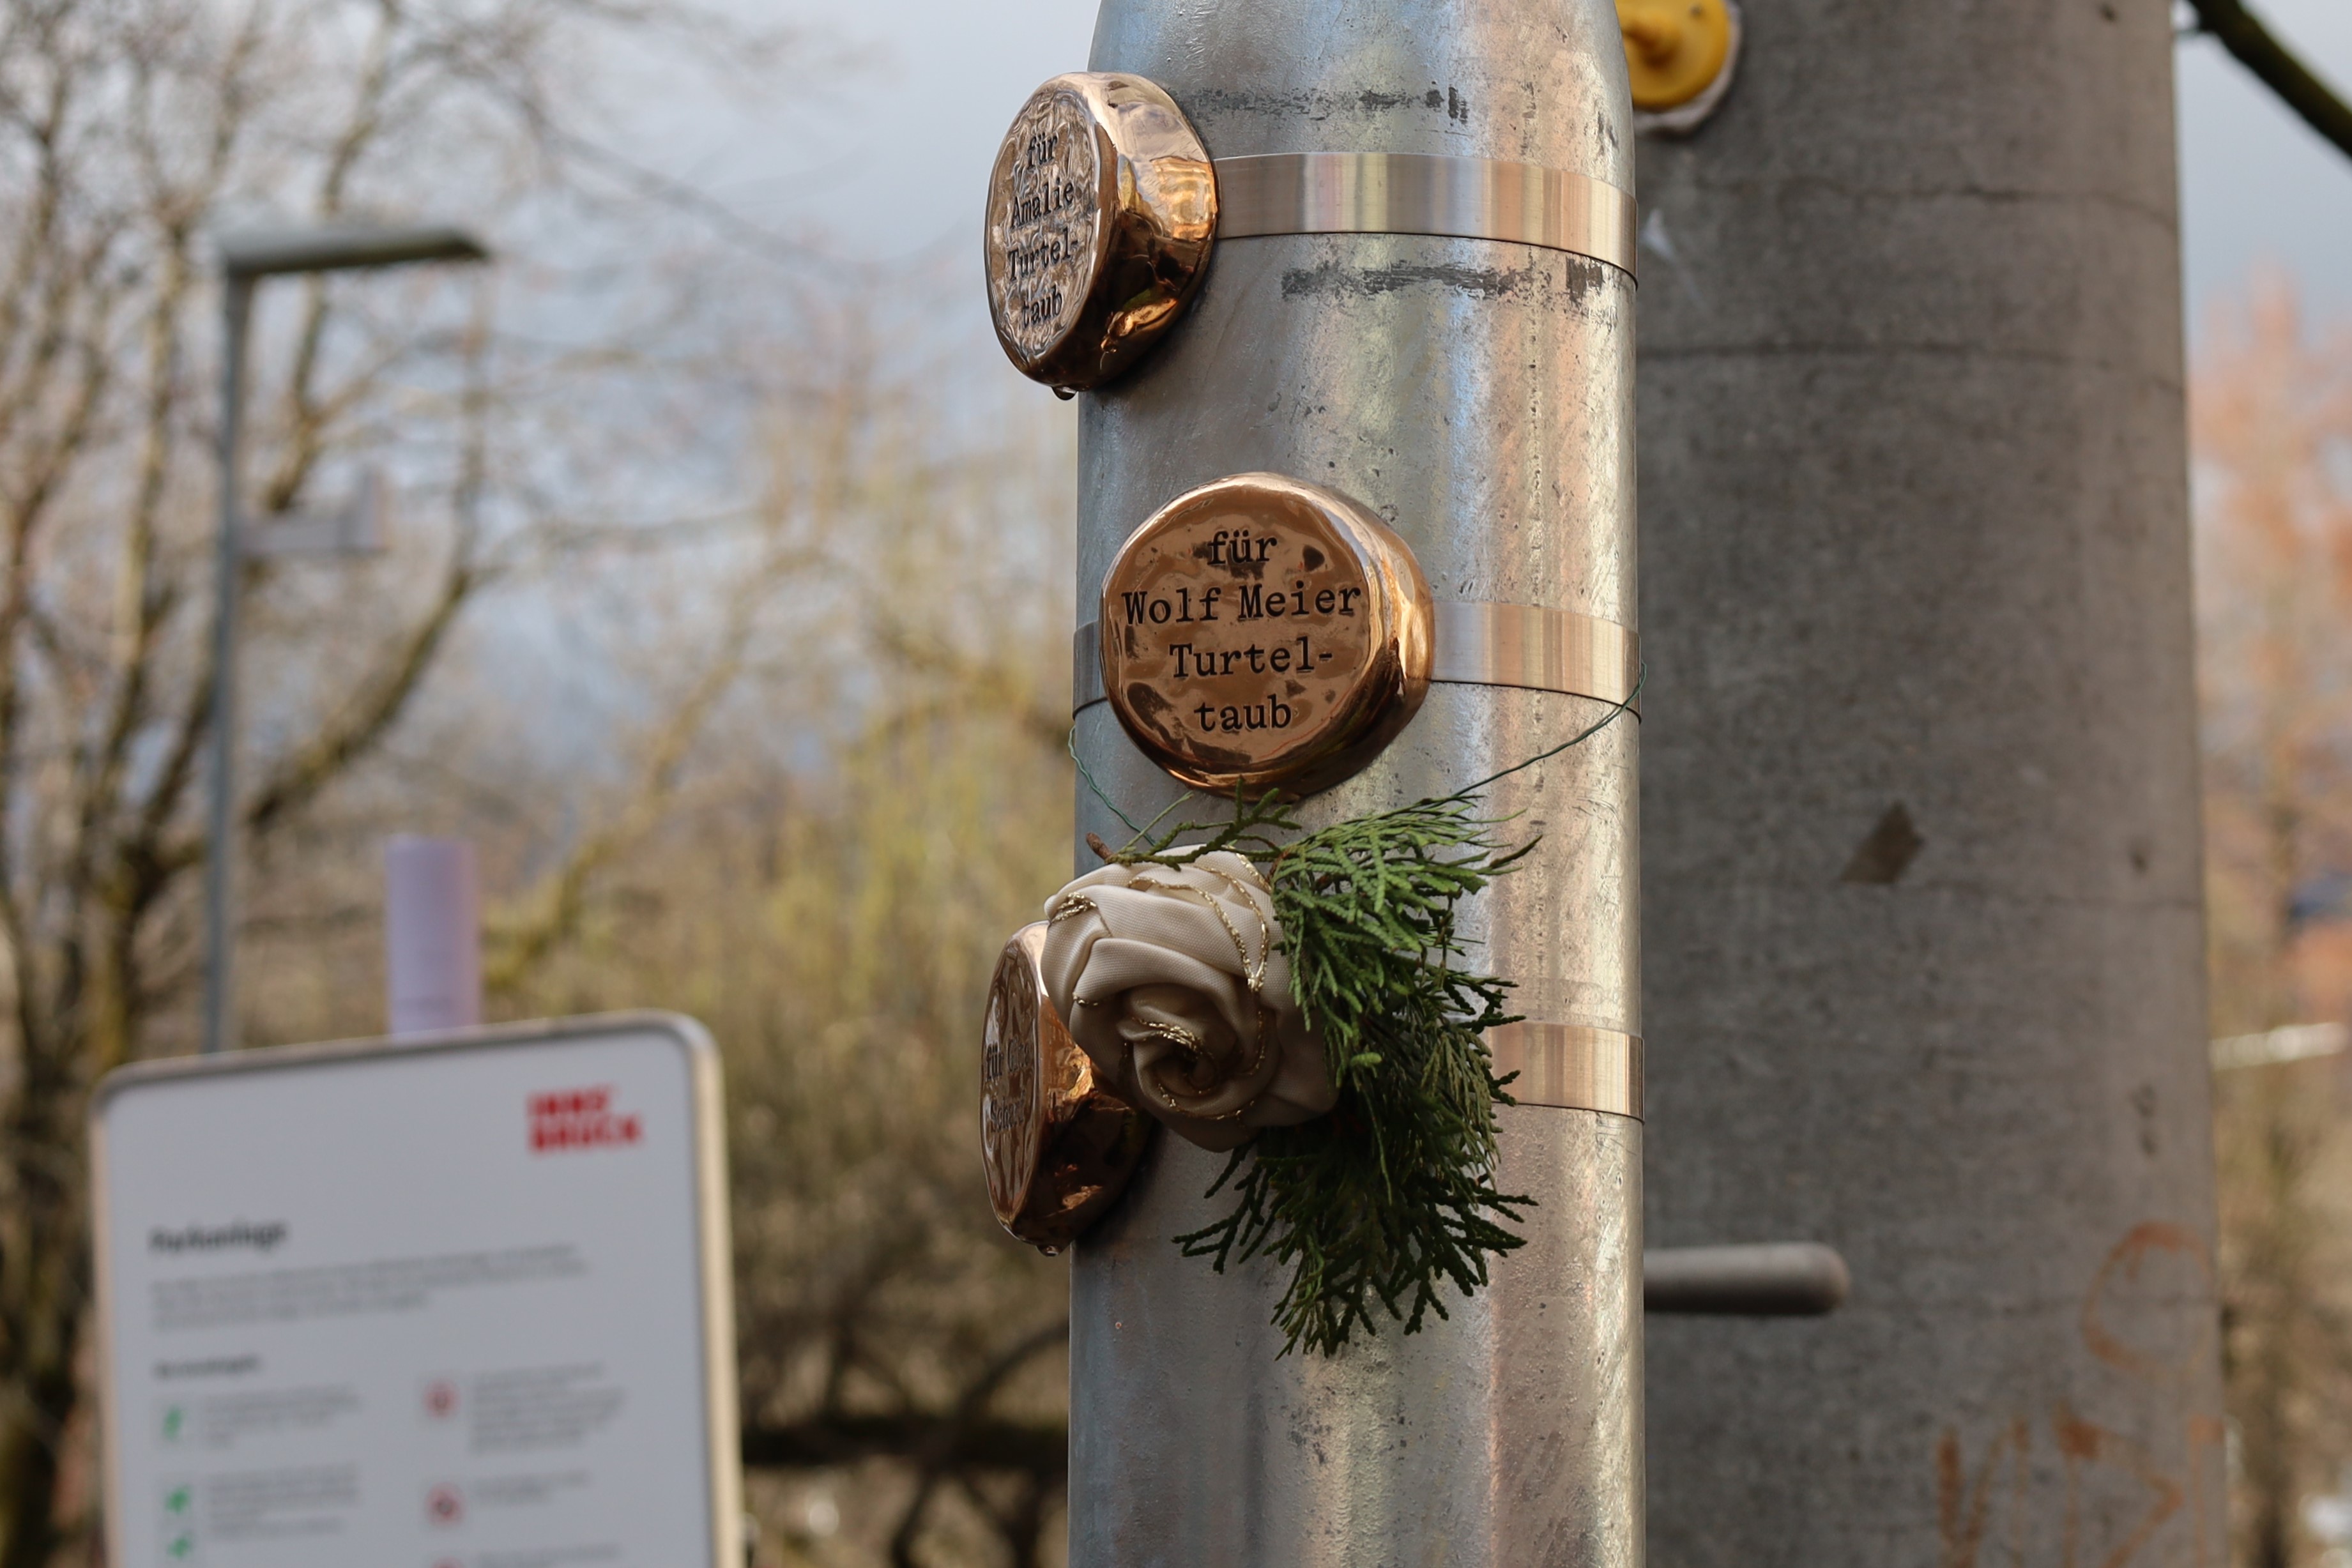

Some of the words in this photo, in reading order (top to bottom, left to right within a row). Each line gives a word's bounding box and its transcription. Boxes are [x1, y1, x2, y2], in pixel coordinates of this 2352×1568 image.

[1027, 133, 1058, 169] für
[1011, 177, 1074, 229] Amalie
[1007, 227, 1078, 282] Turtel-
[1022, 285, 1062, 329] taub
[1207, 530, 1278, 566] für
[1122, 587, 1221, 625] Wolf
[1238, 580, 1361, 621] Meier
[1170, 637, 1333, 678] Turtel-
[1195, 694, 1292, 732] taub
